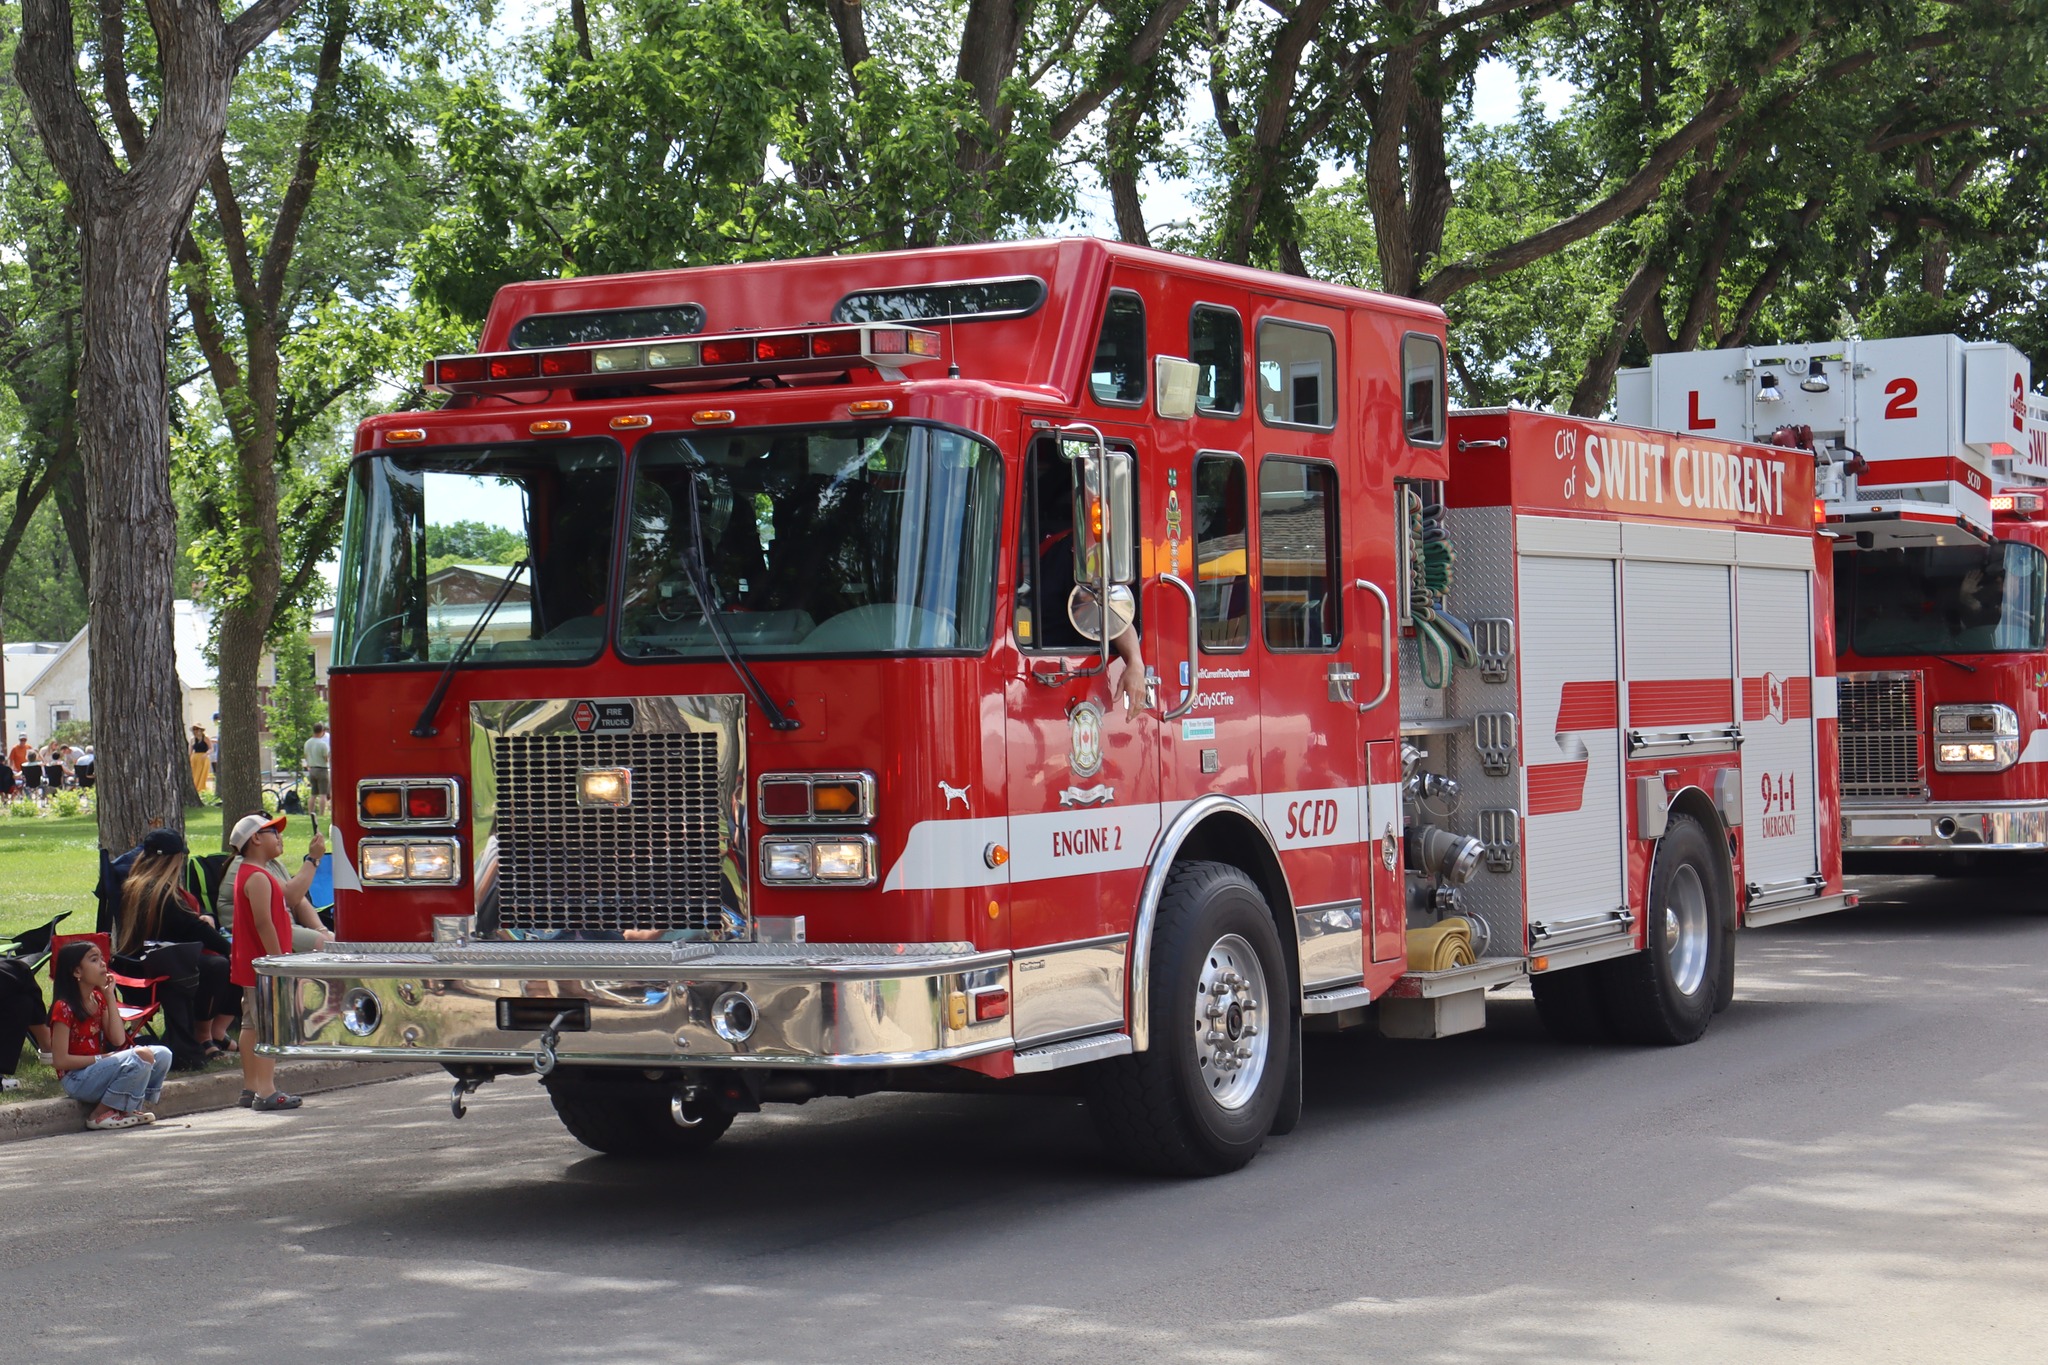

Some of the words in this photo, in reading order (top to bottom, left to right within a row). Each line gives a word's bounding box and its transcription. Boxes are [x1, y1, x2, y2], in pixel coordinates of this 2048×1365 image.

[1688, 391, 1716, 430] L
[1884, 377, 1918, 420] 2
[1554, 428, 1577, 460] City
[1563, 465, 1577, 499] of
[1584, 434, 1665, 504] SWIFT
[1673, 446, 1786, 516] CURRENT
[1967, 470, 1981, 490] SCFD
[606, 708, 622, 716] FIRE
[1761, 771, 1795, 815] 9-1-1
[1285, 799, 1338, 839] SCFD
[1763, 814, 1795, 838] EMERGENCY
[1053, 827, 1109, 857] ENGINE
[1114, 826, 1122, 850] 2
